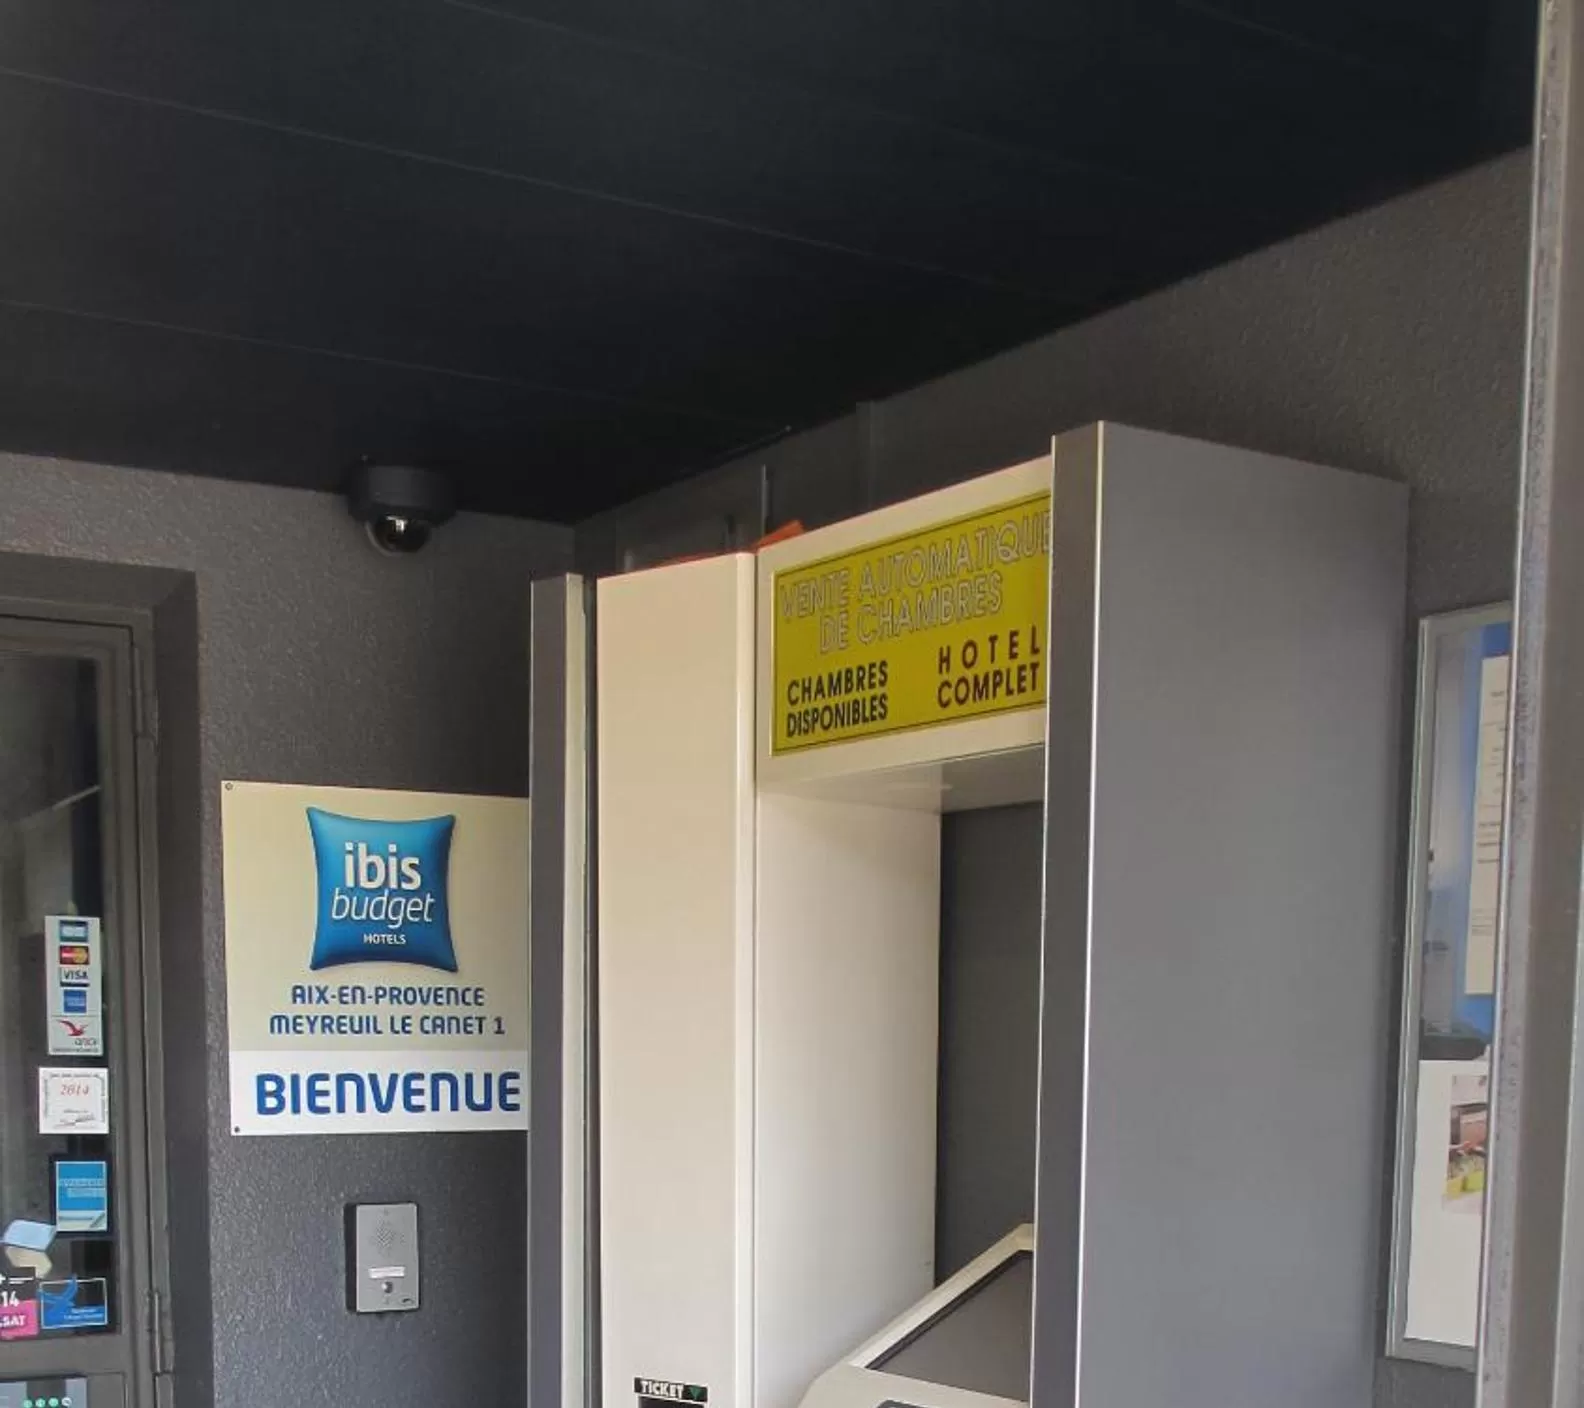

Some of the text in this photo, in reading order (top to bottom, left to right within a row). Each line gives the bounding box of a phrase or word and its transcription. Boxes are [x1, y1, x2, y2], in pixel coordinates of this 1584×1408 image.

[780, 566, 851, 622] VENTE
[819, 570, 1004, 655] DE CHAMBRES
[938, 625, 1041, 675] HOTEL
[787, 660, 889, 706] CHAMBRES
[937, 661, 1041, 709] COMPLET
[786, 692, 889, 738] DISPONIBLES
[344, 842, 423, 891] ibis
[331, 887, 437, 929] budget
[363, 933, 407, 945] HOTELS
[63, 970, 89, 980] VISA
[291, 985, 486, 1008] AIX-EN-PROVENCE
[269, 1014, 507, 1036] MEYREUIL LE CANET 1
[255, 1070, 522, 1117] BIENVENUE
[0, 1314, 26, 1328] SAT
[640, 1380, 684, 1399] TICKET
